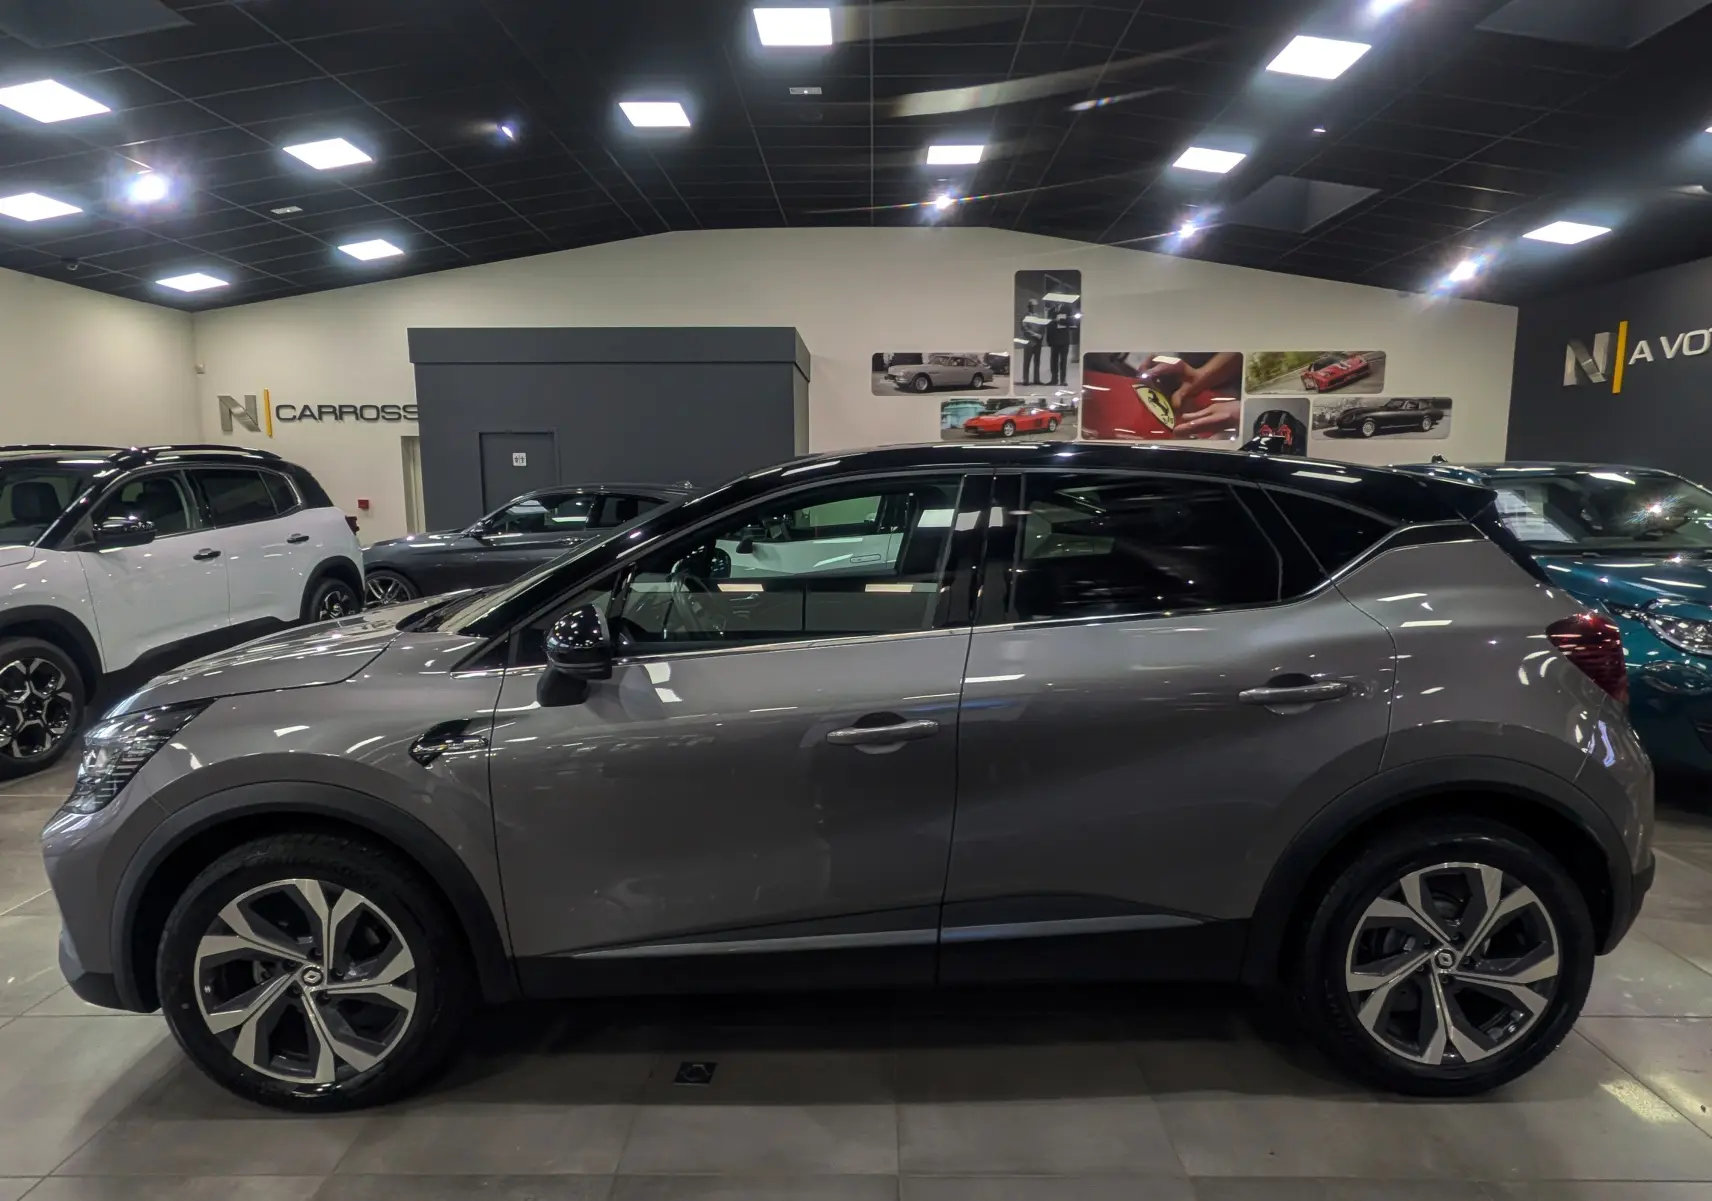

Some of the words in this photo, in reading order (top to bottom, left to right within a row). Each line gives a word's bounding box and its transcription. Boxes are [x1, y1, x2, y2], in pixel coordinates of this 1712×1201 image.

[1563, 332, 1610, 386] N
[1628, 340, 1654, 366] A
[1660, 328, 1712, 359] VO
[217, 394, 261, 433] N
[275, 404, 418, 422] CARROSS
